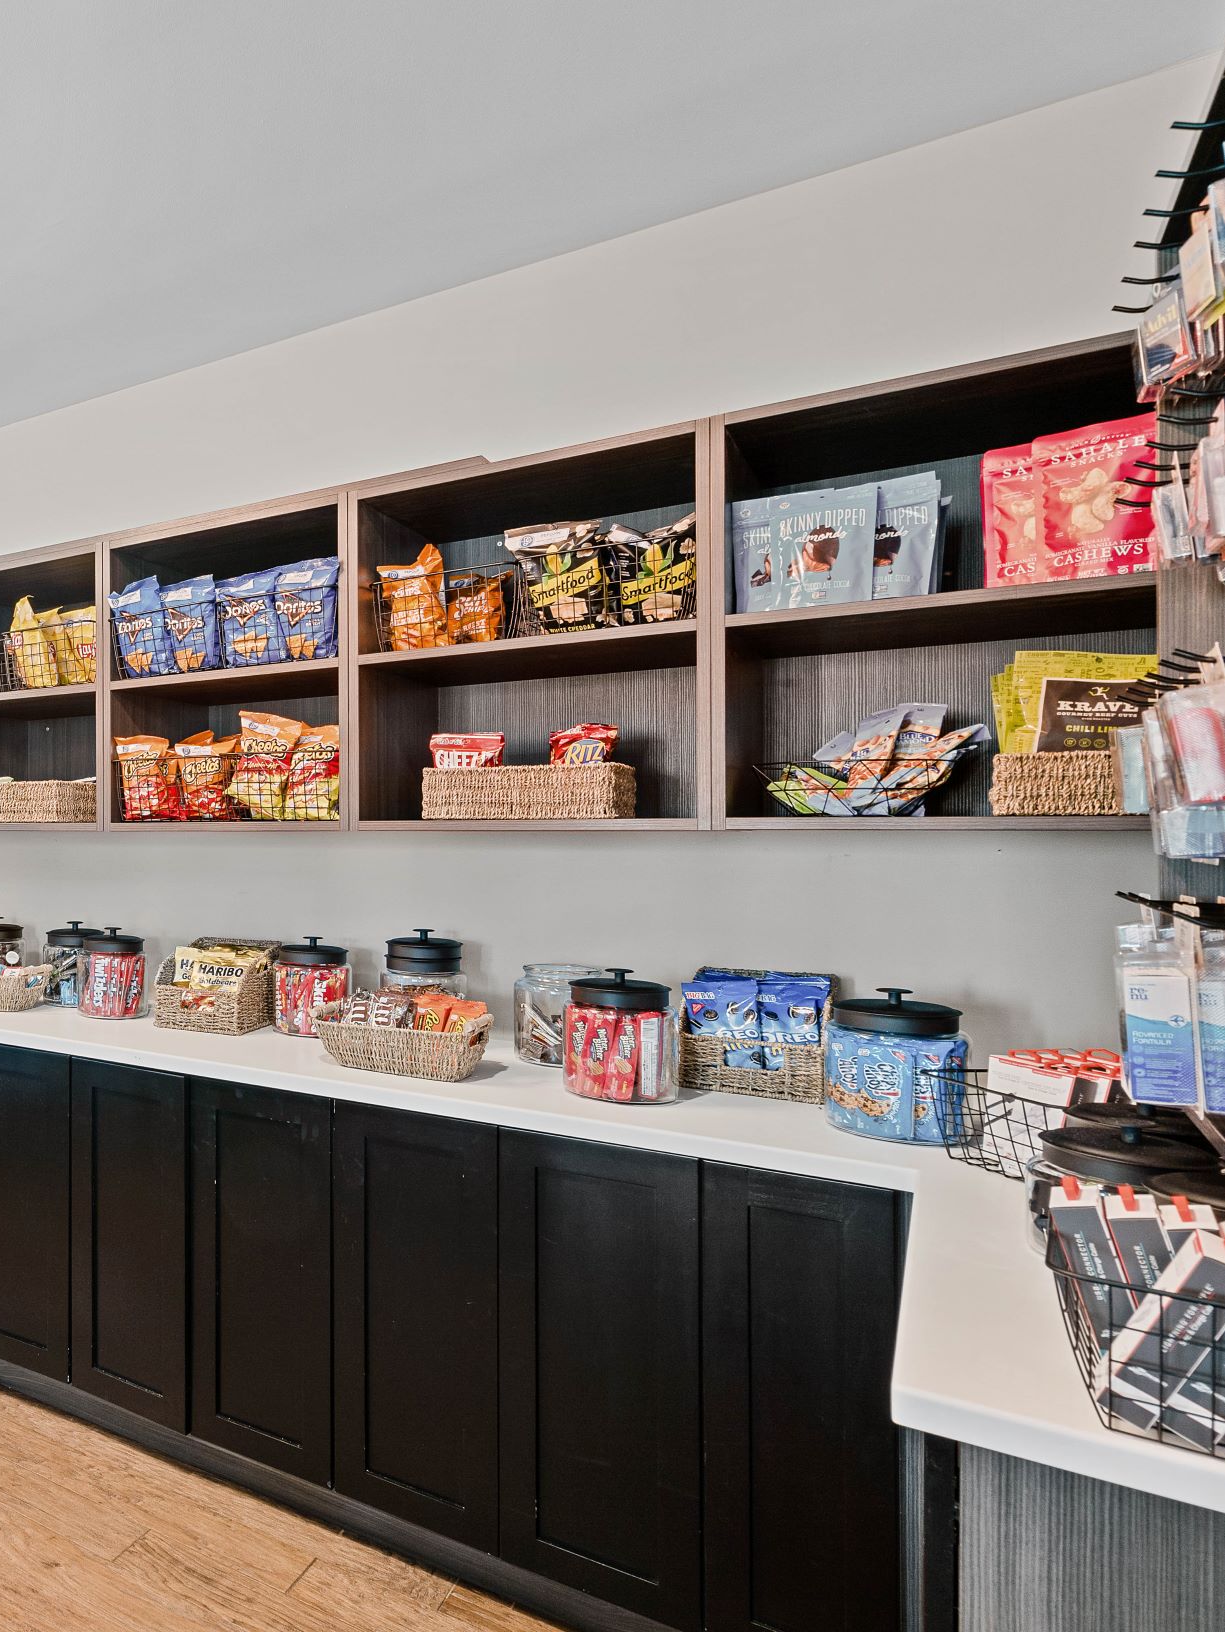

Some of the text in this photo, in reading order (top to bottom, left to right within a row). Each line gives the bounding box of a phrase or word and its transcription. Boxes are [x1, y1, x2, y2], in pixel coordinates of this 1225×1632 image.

[1051, 434, 1146, 465] SAHALE
[1070, 450, 1124, 468] SNACKS
[779, 508, 866, 538] SKINNY DIPPED
[885, 505, 928, 528] DIPPED
[742, 526, 771, 549] SKIN
[794, 526, 848, 543] almonds
[875, 525, 909, 541] onds
[1054, 543, 1144, 566] CASHEWS
[1087, 540, 1118, 549] VANILLA
[530, 565, 596, 604] Smartfood
[621, 567, 694, 601] Smartfood
[275, 600, 323, 615] Doritos
[549, 623, 596, 634] WHITE CHEDDAR
[1056, 700, 1139, 713] KRAVE
[896, 734, 936, 745] AMOND
[899, 731, 923, 740] BLUE
[1065, 725, 1095, 733] CHILI
[242, 737, 289, 759] Cheetos
[565, 741, 606, 767] RITZ
[183, 757, 221, 784] Cheetos
[199, 963, 244, 978] HARIBO
[685, 991, 716, 1000] BIG BAG
[596, 1028, 608, 1051] Nutter
[619, 1034, 631, 1058] Butter
[623, 1024, 636, 1049] Nutter
[1132, 1031, 1174, 1039] ADVANCED
[592, 1038, 604, 1061] Butter
[1074, 1233, 1095, 1277] CONNECTOR
